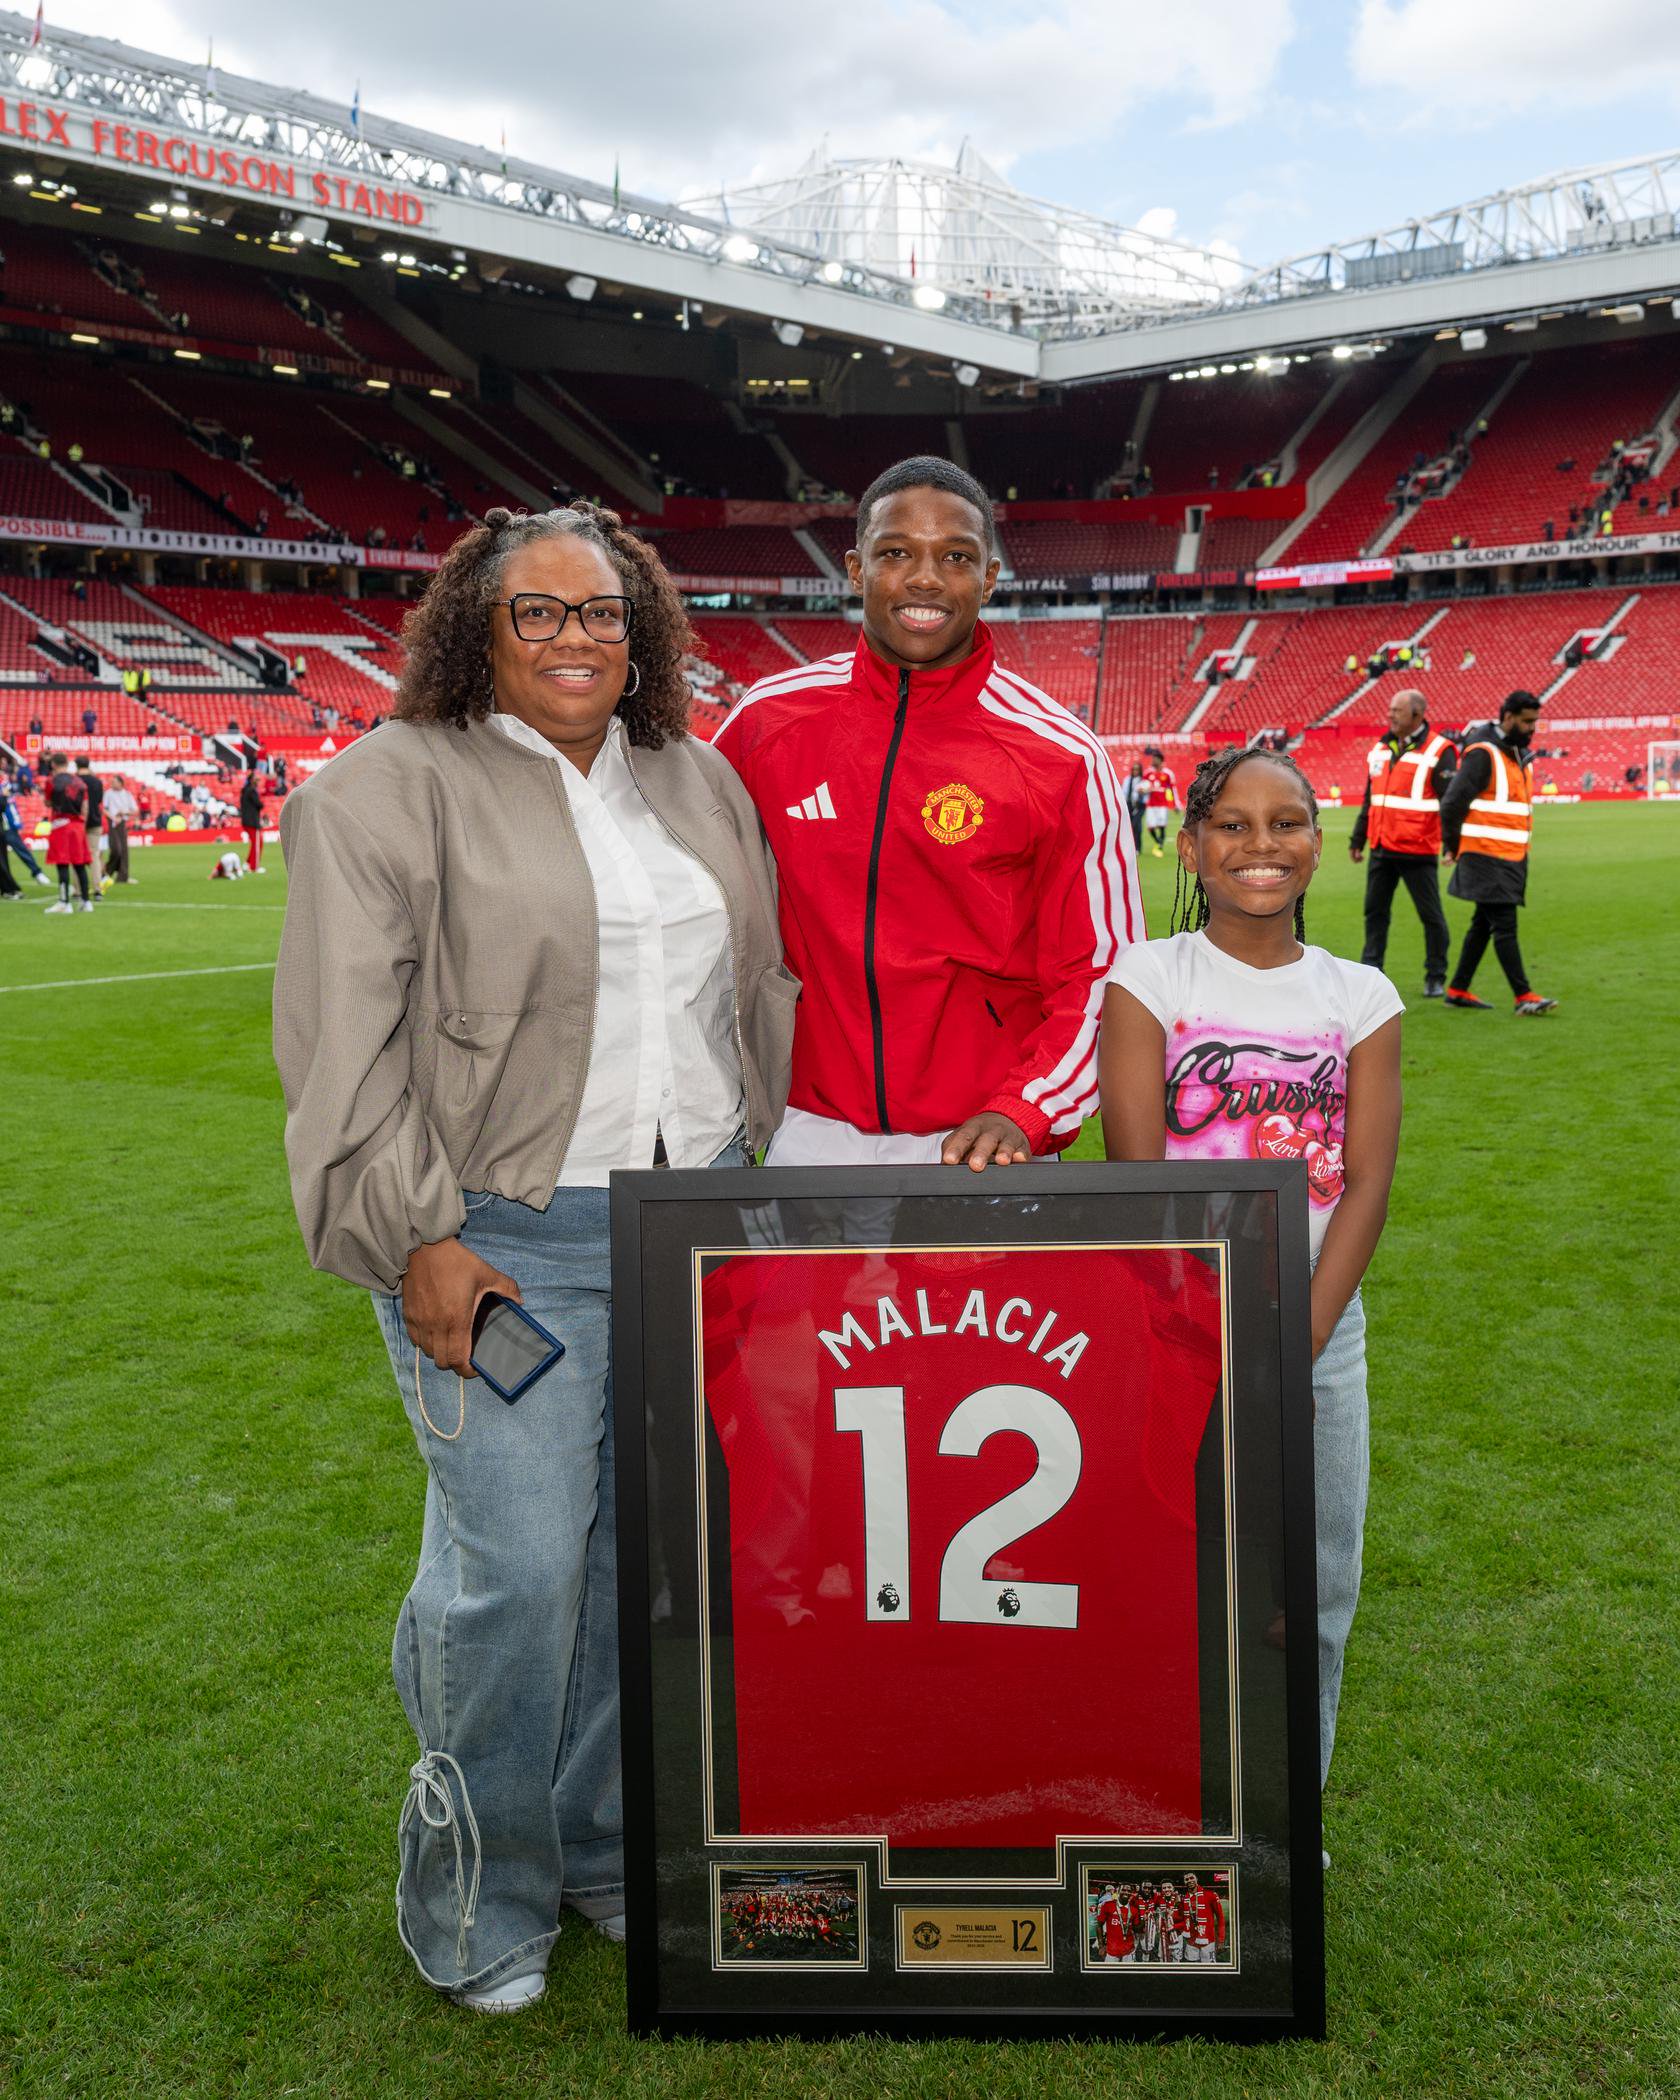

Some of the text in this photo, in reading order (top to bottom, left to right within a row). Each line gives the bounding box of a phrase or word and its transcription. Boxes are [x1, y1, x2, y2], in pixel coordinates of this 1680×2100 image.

[92, 119, 296, 199] FERGUSON
[312, 171, 424, 227] STAND
[1464, 547, 1518, 564] GLORY
[1526, 544, 1561, 558] AND
[930, 787, 979, 810] MANCHESTER
[931, 826, 966, 841] UNITED
[817, 1288, 1091, 1380] MALACIA
[834, 1383, 1083, 1630] 12
[1011, 1919, 1039, 1953] 12
